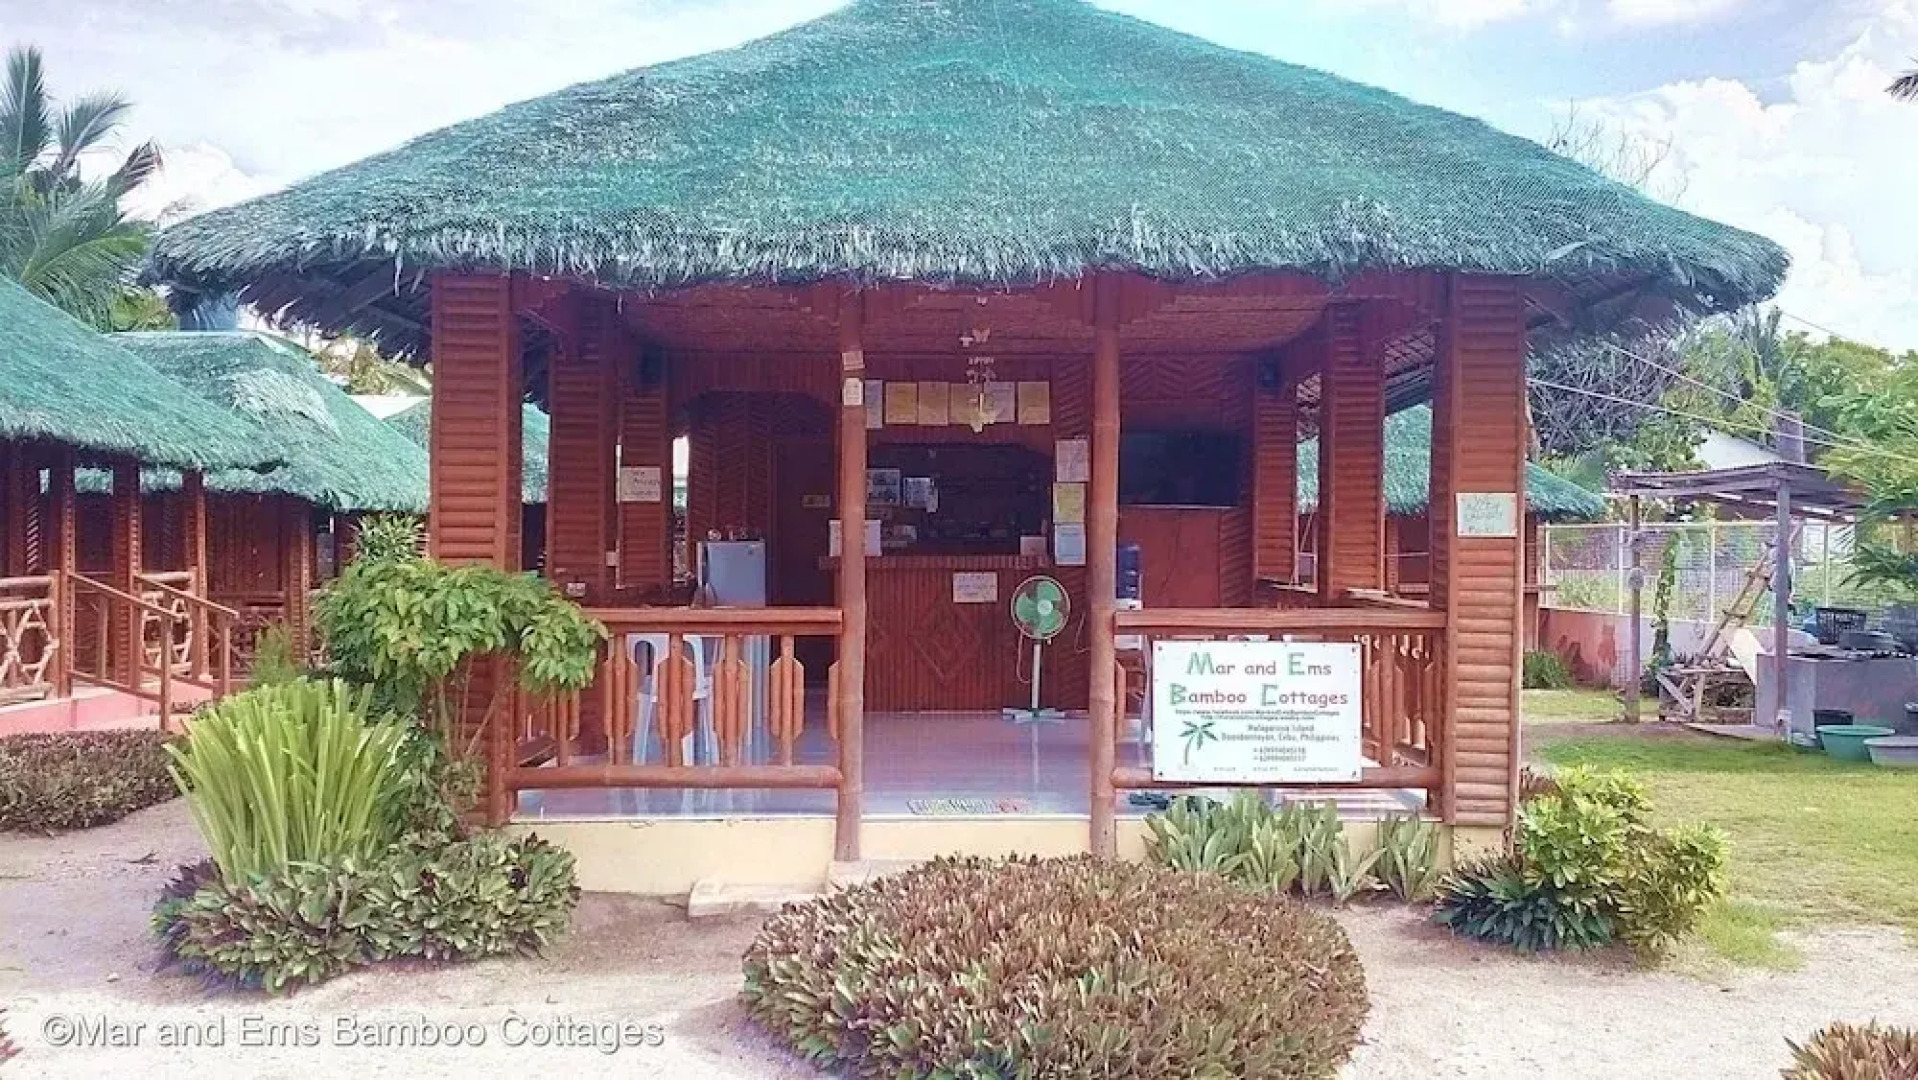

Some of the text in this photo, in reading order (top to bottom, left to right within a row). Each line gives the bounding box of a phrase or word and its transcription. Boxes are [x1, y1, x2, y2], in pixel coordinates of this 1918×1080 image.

[1186, 652, 1332, 675] Mar and Ems
[1169, 683, 1349, 708] Bamboo Cottages
